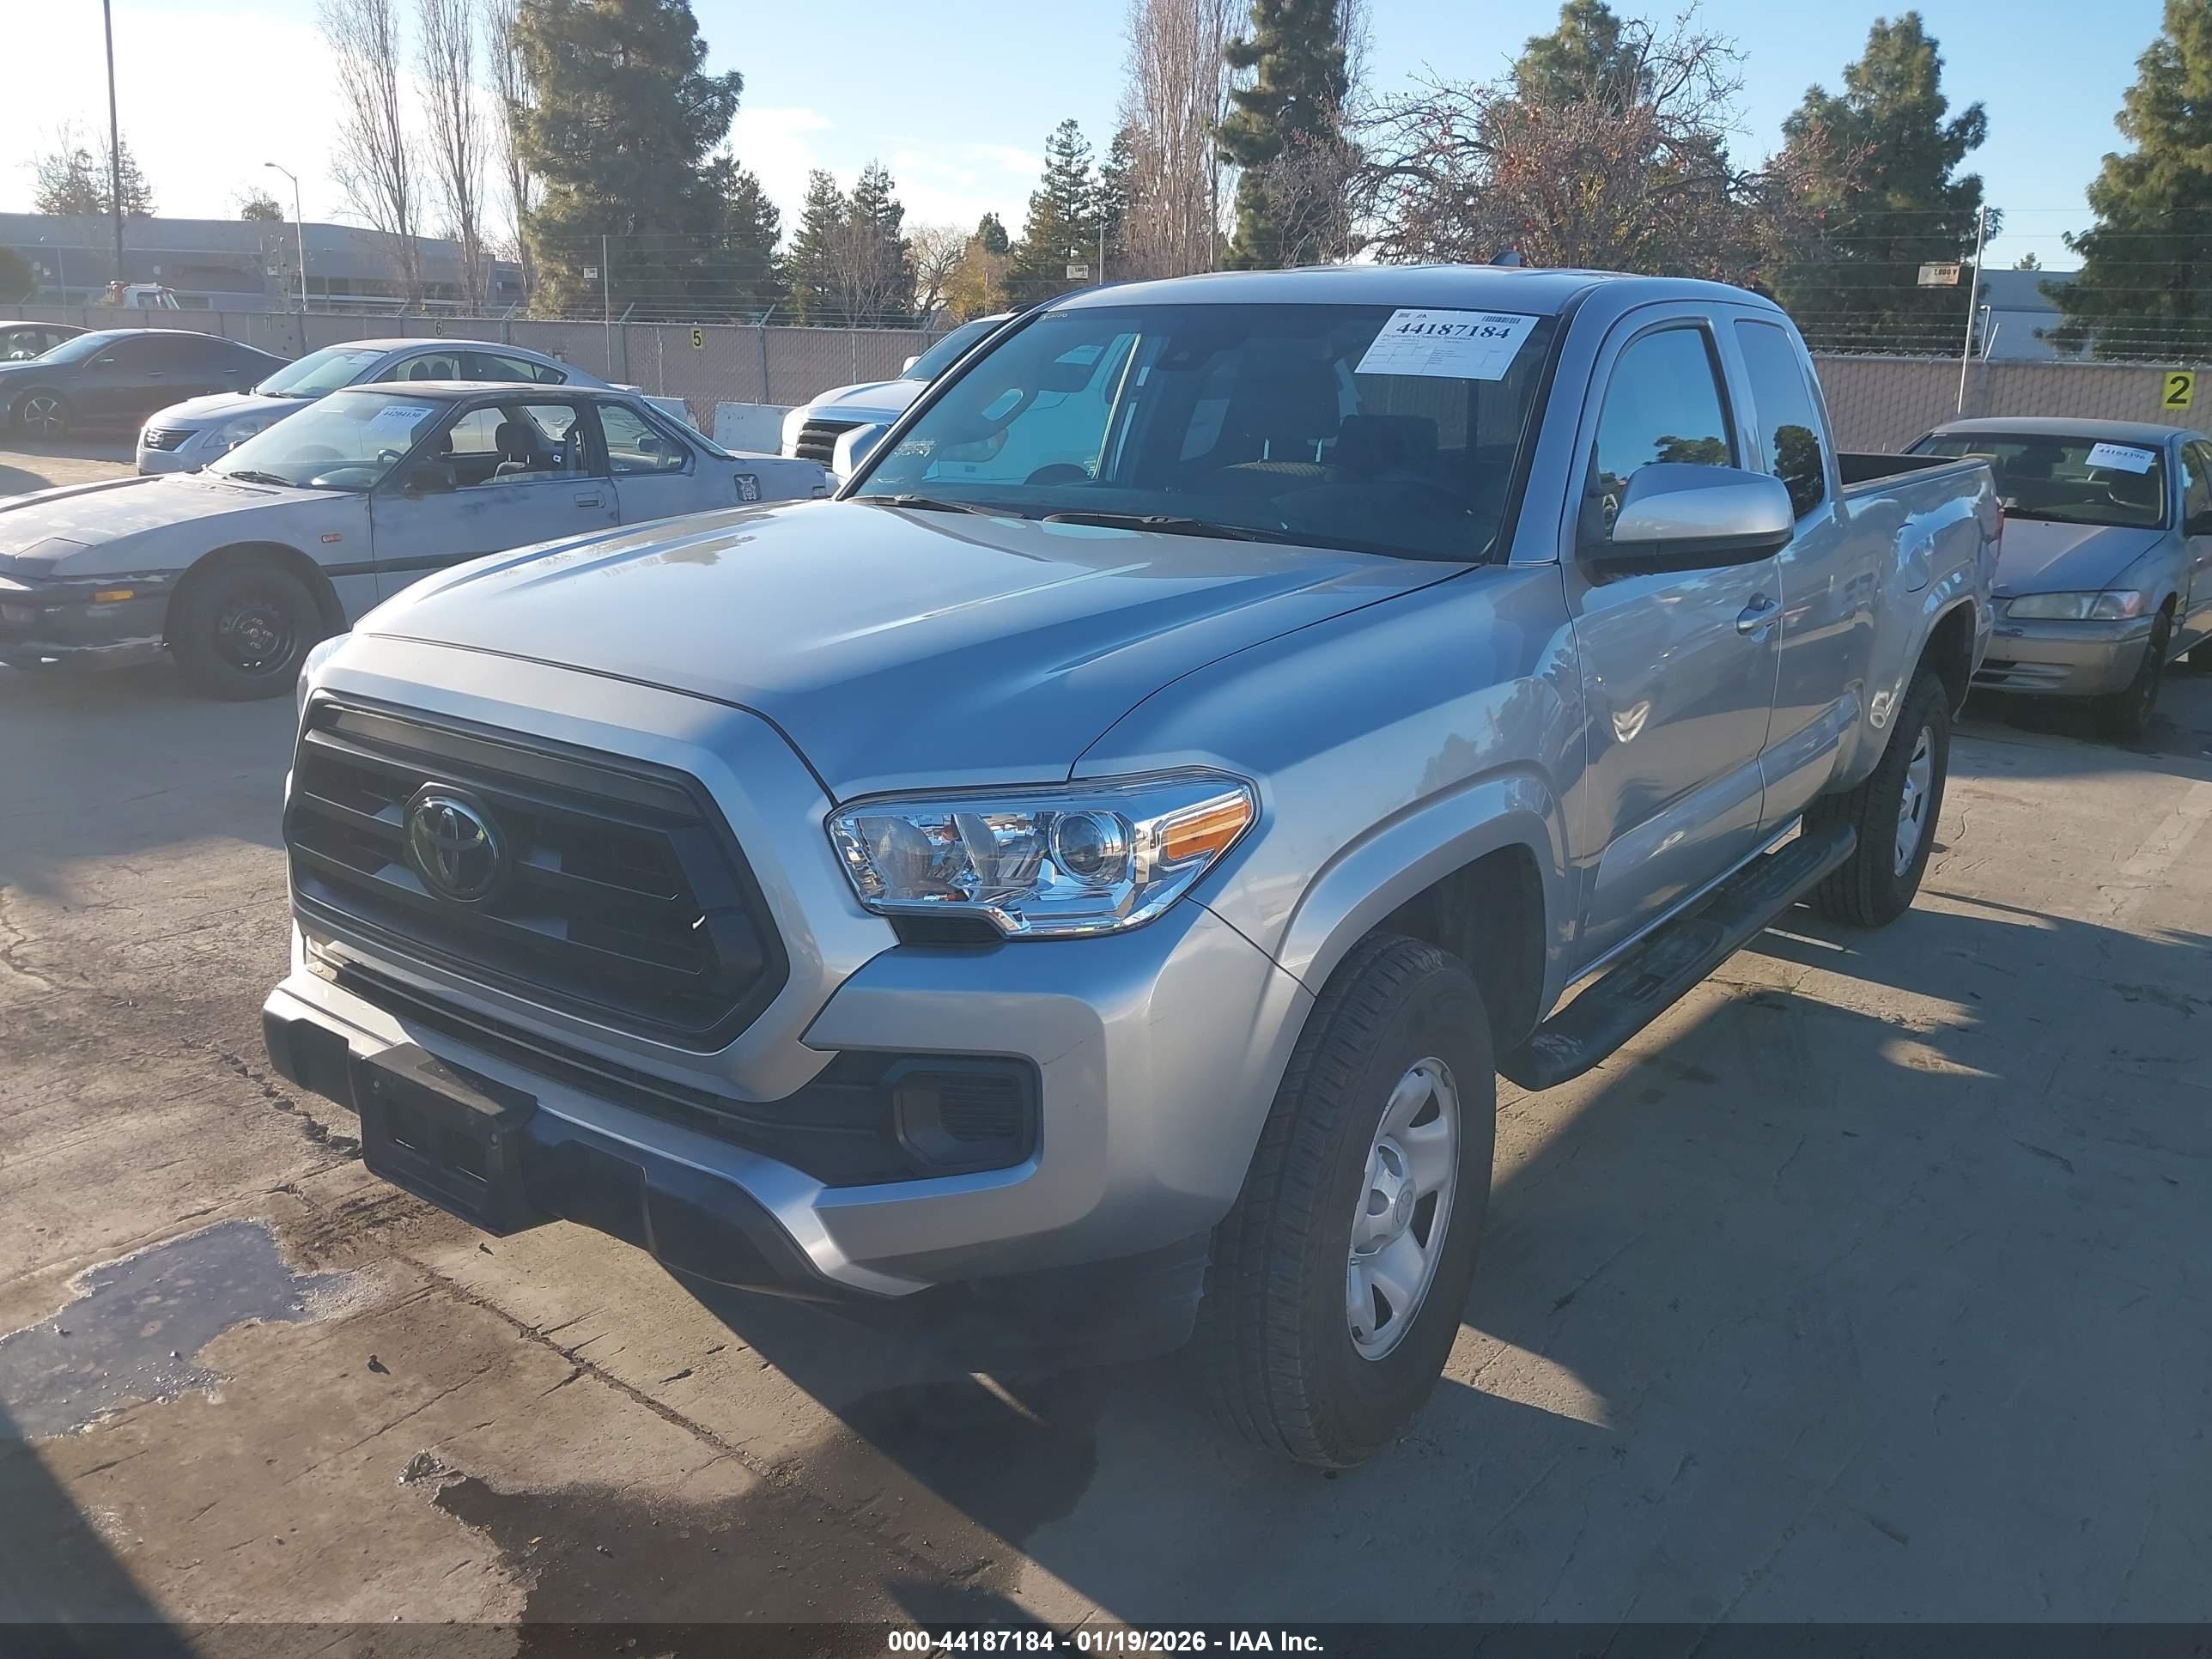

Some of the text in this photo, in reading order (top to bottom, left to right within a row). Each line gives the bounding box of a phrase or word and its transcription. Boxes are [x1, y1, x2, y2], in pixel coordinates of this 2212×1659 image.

[435, 321, 442, 336] 6
[1395, 322, 1511, 339] 44187184
[693, 330, 702, 347] 5
[2166, 375, 2190, 404] 2
